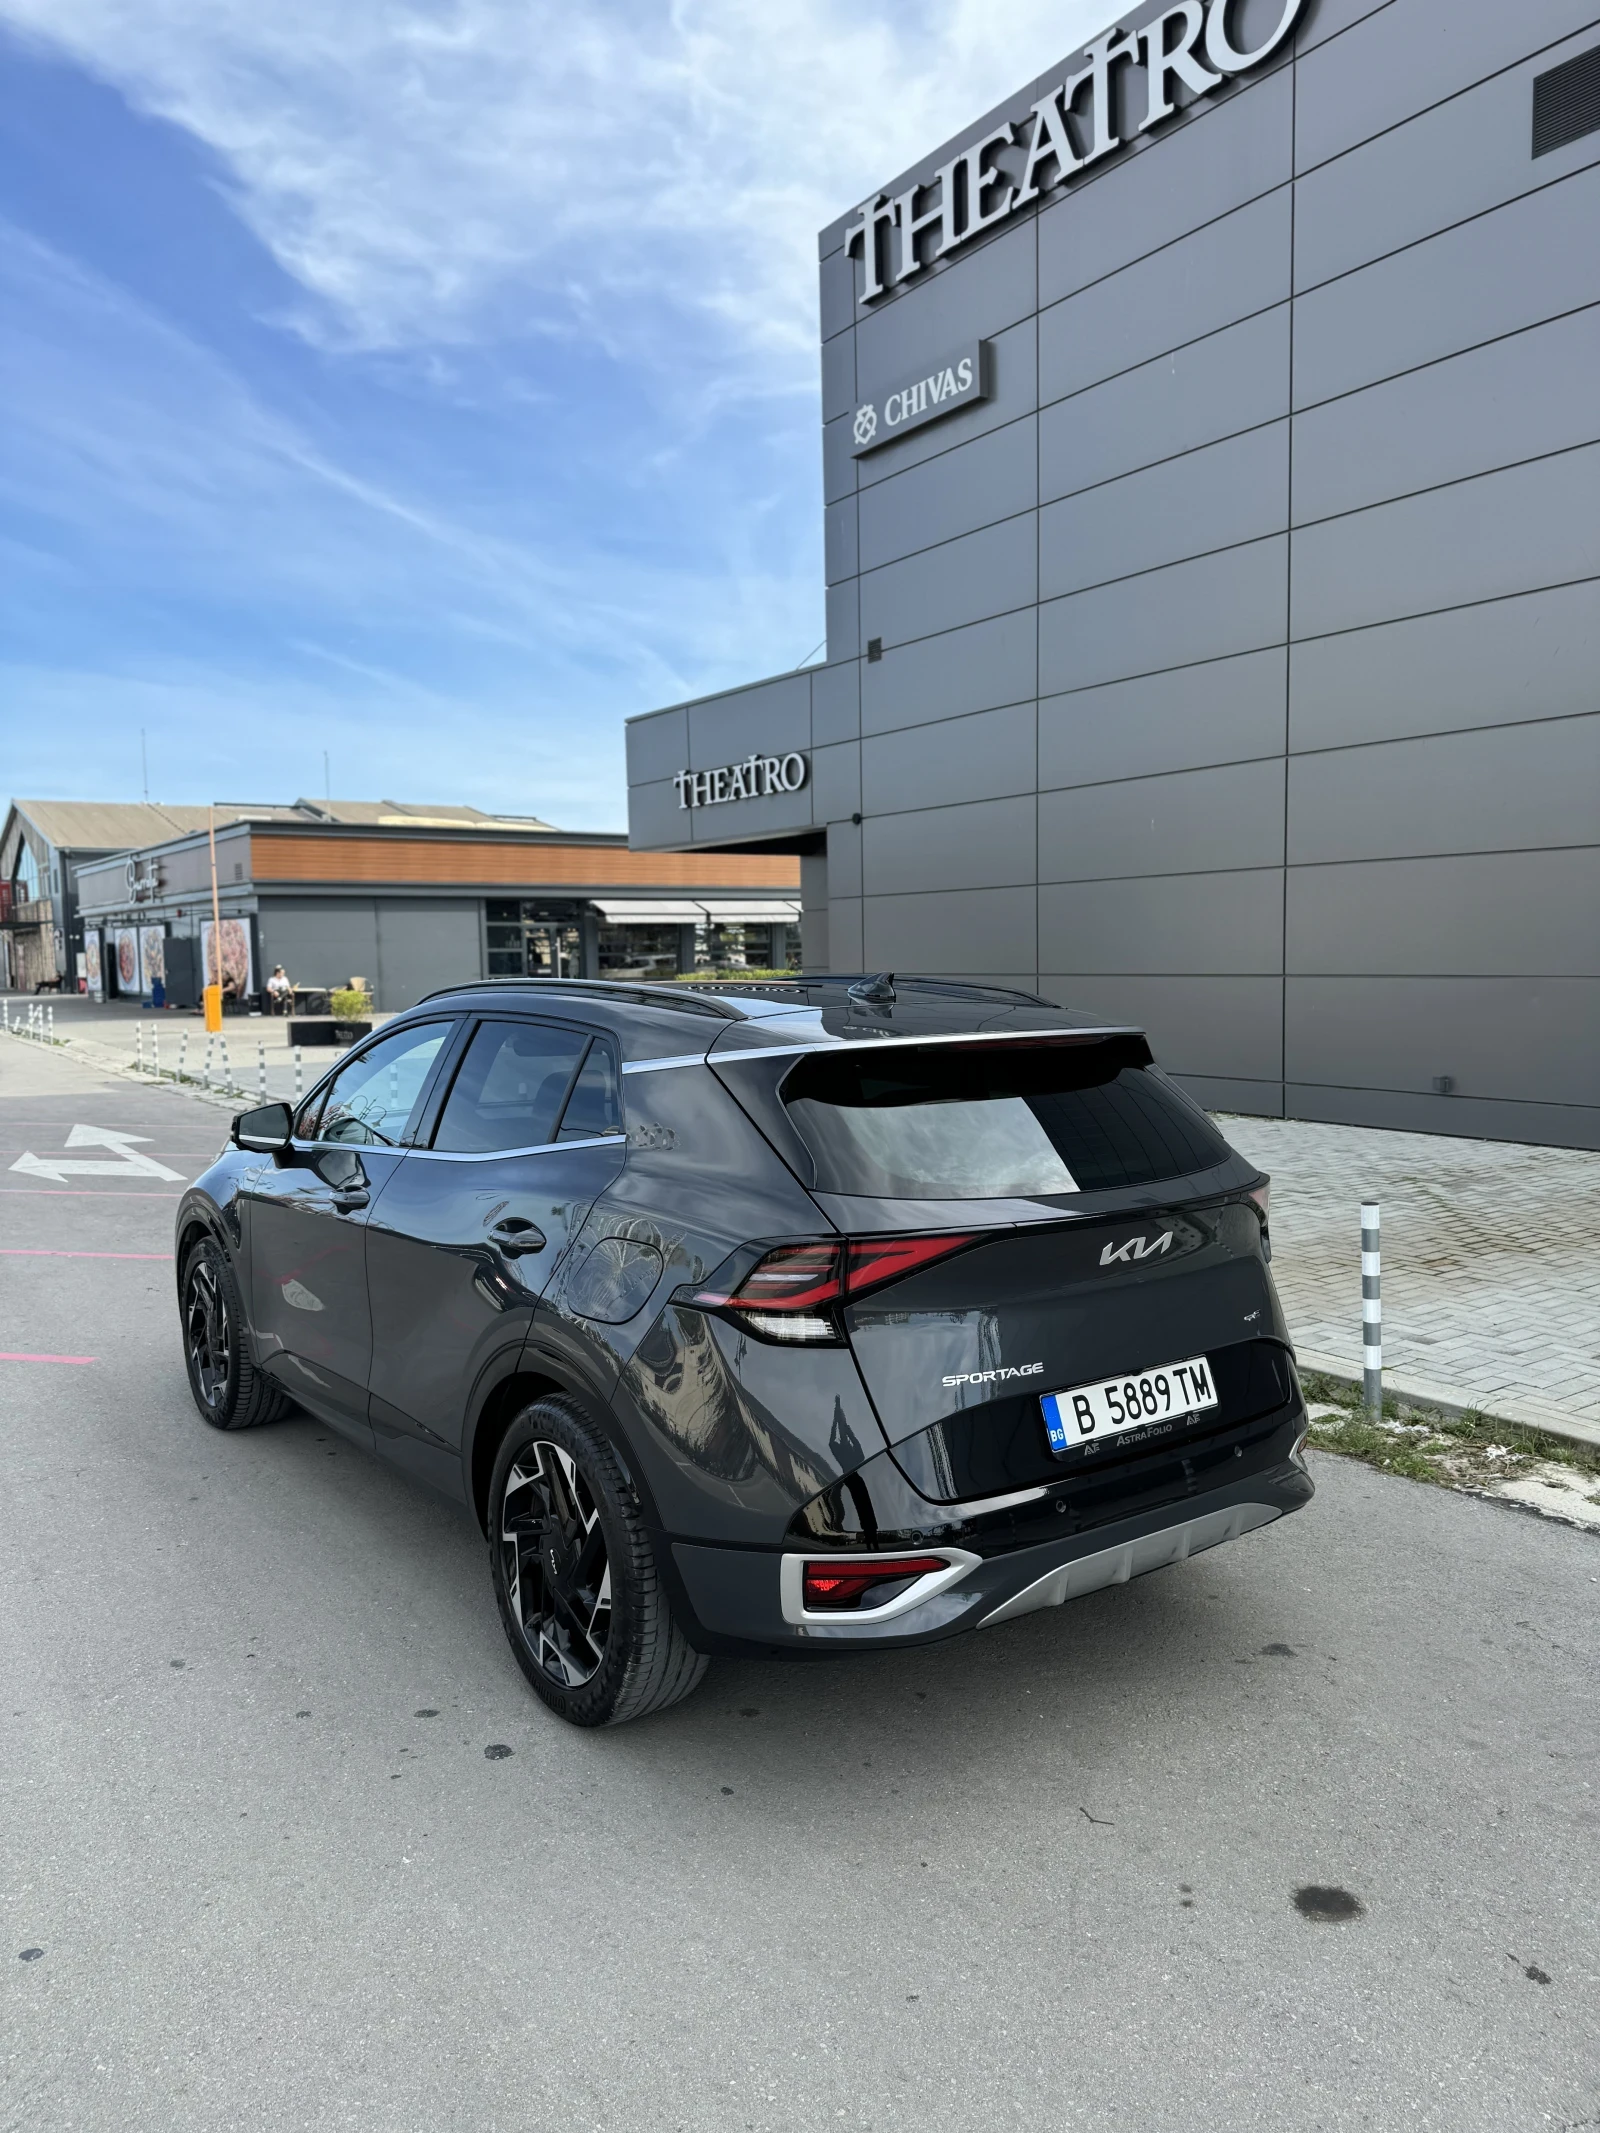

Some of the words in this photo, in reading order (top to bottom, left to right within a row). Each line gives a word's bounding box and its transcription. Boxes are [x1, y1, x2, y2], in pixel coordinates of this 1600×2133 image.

[845, 0, 1301, 304] THEATRO
[884, 358, 973, 426] CHIVAS
[673, 752, 805, 809] THEATRO
[1099, 1231, 1174, 1266] KIA
[942, 1362, 1045, 1387] SPORTAGE
[1072, 1394, 1096, 1435] B
[1104, 1374, 1171, 1425] 5889
[1173, 1363, 1212, 1405] TM
[1050, 1428, 1064, 1442] BG
